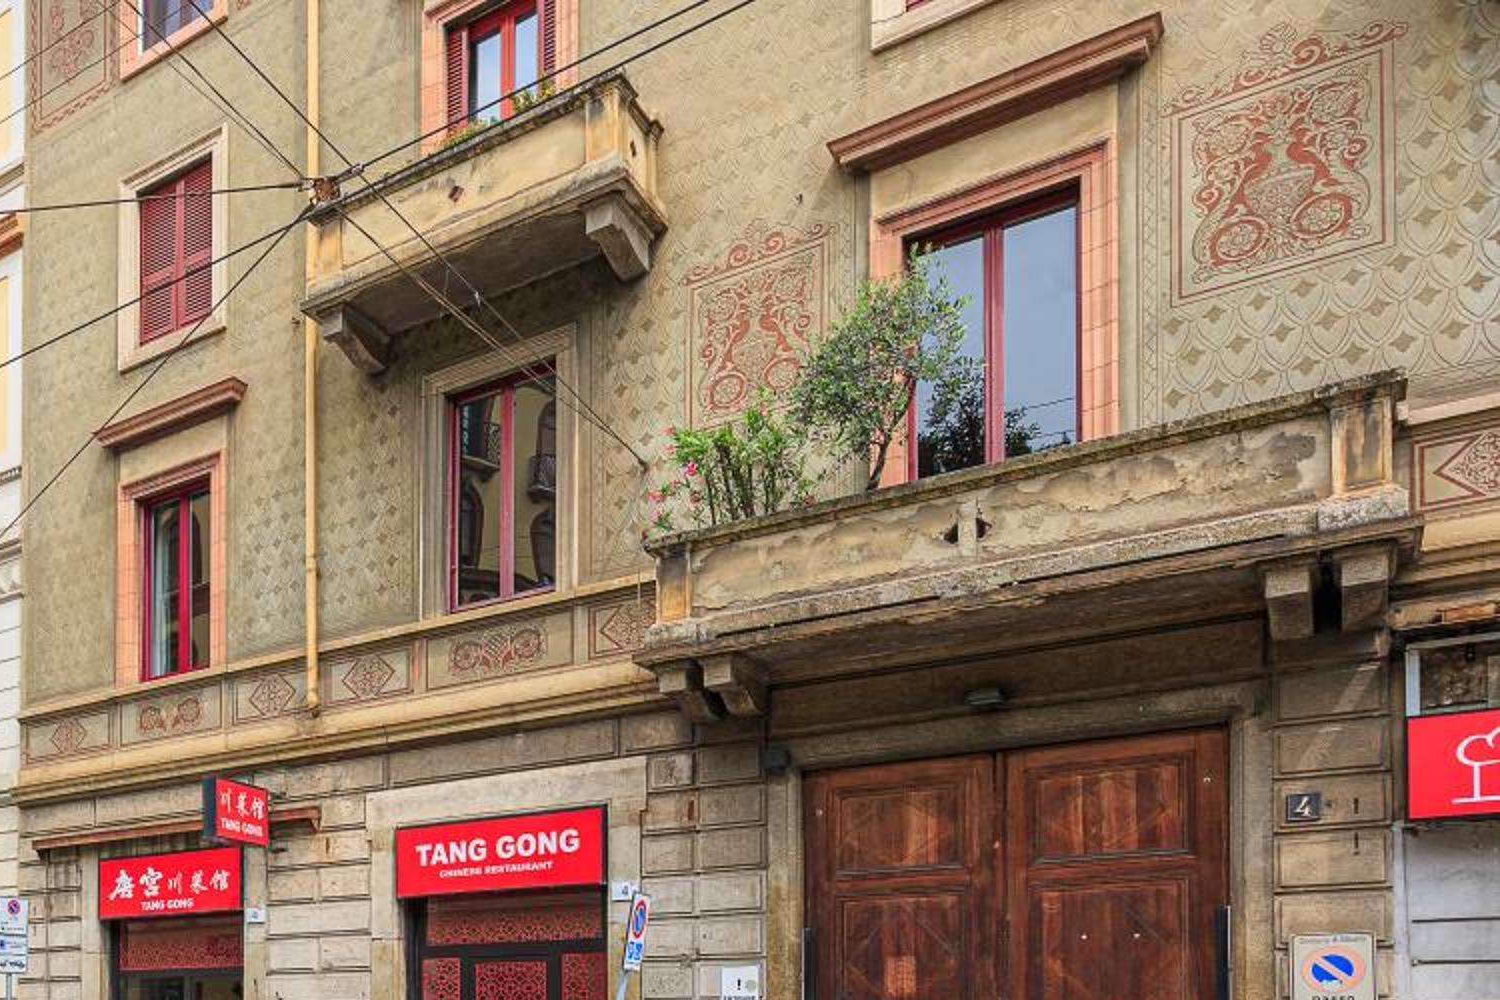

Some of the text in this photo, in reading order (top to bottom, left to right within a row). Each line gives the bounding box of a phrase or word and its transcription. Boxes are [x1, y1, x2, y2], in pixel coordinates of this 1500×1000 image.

[1294, 796, 1312, 816] 4
[220, 817, 241, 833] TANG
[415, 828, 581, 867] TANG GONG
[439, 861, 554, 878] CHINESE RESTAURANT
[140, 897, 195, 911] TANG GONG
